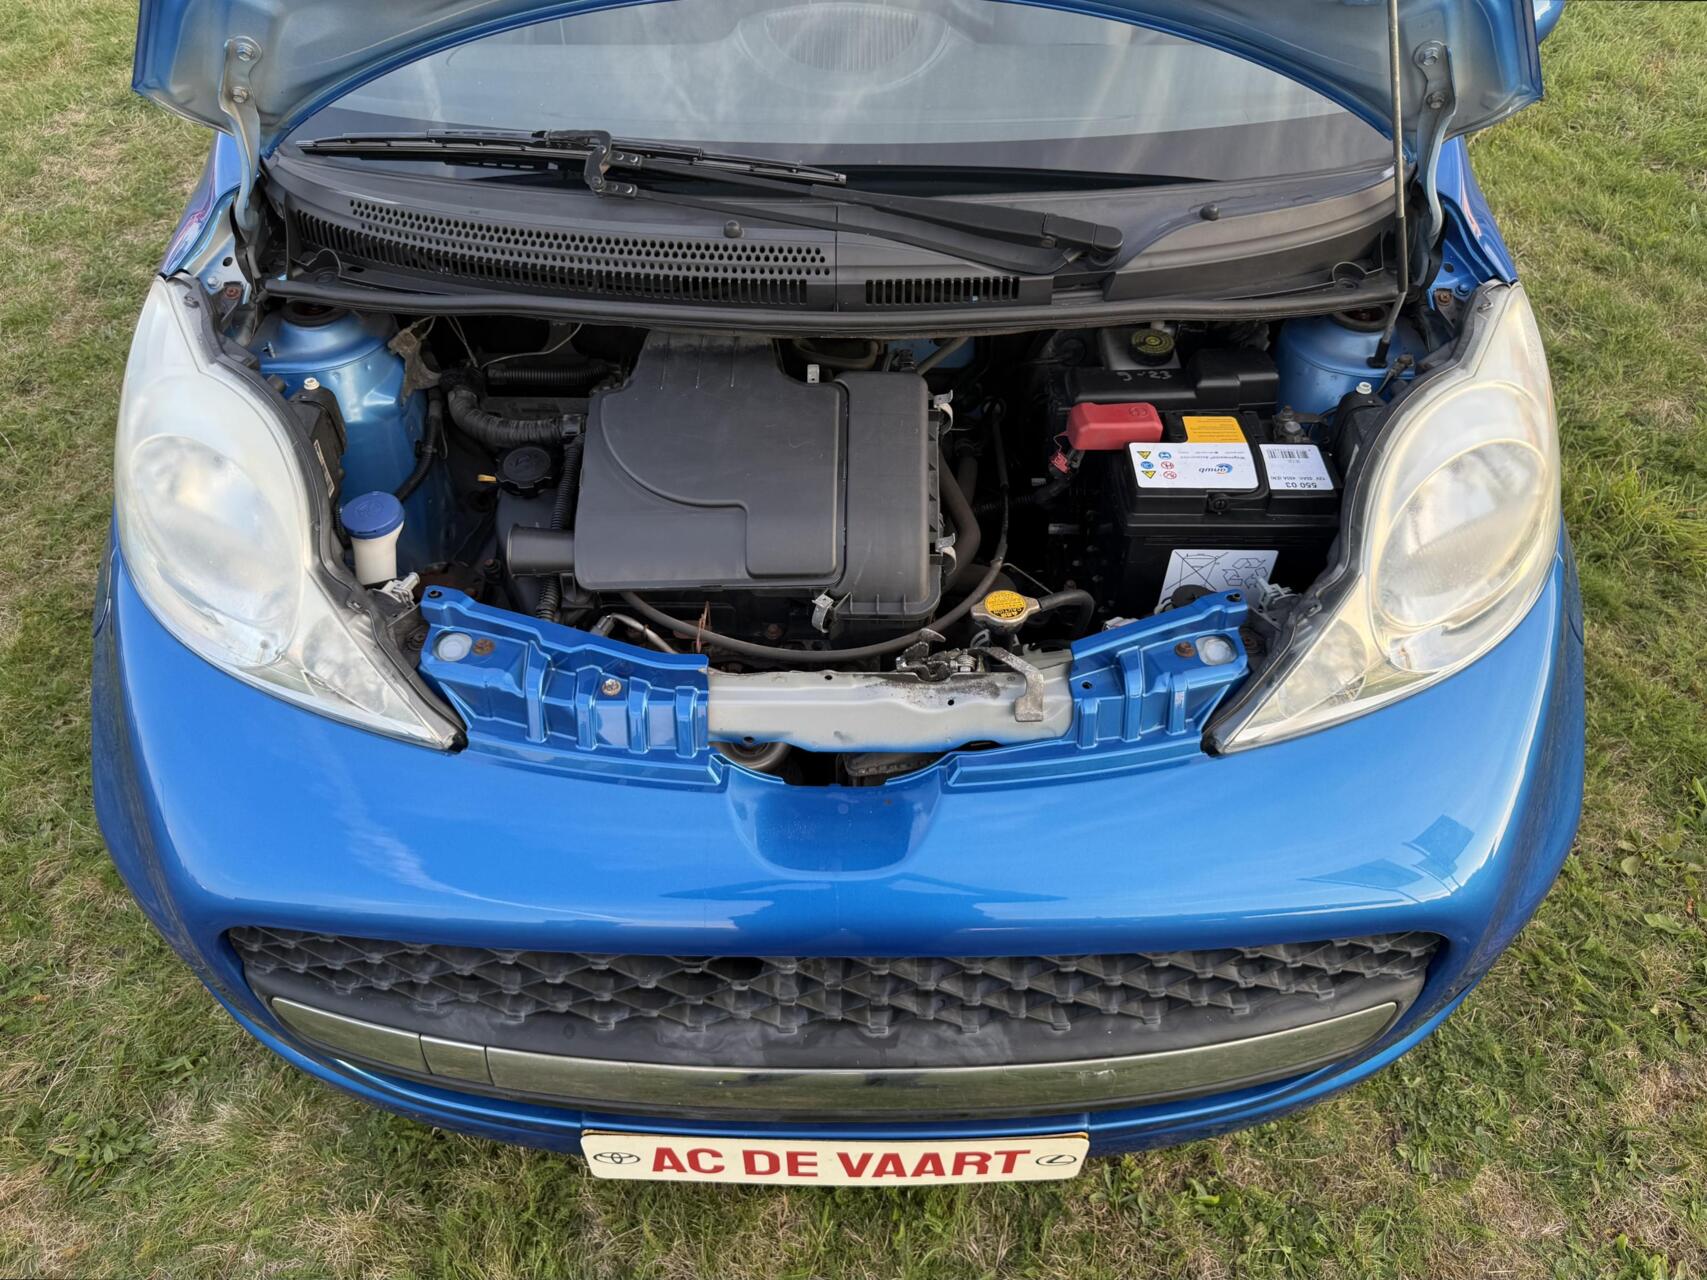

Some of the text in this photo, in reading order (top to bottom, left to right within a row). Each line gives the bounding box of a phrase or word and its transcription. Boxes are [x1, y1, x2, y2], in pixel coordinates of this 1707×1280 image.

[652, 1147, 1031, 1179] AC DE VAART
